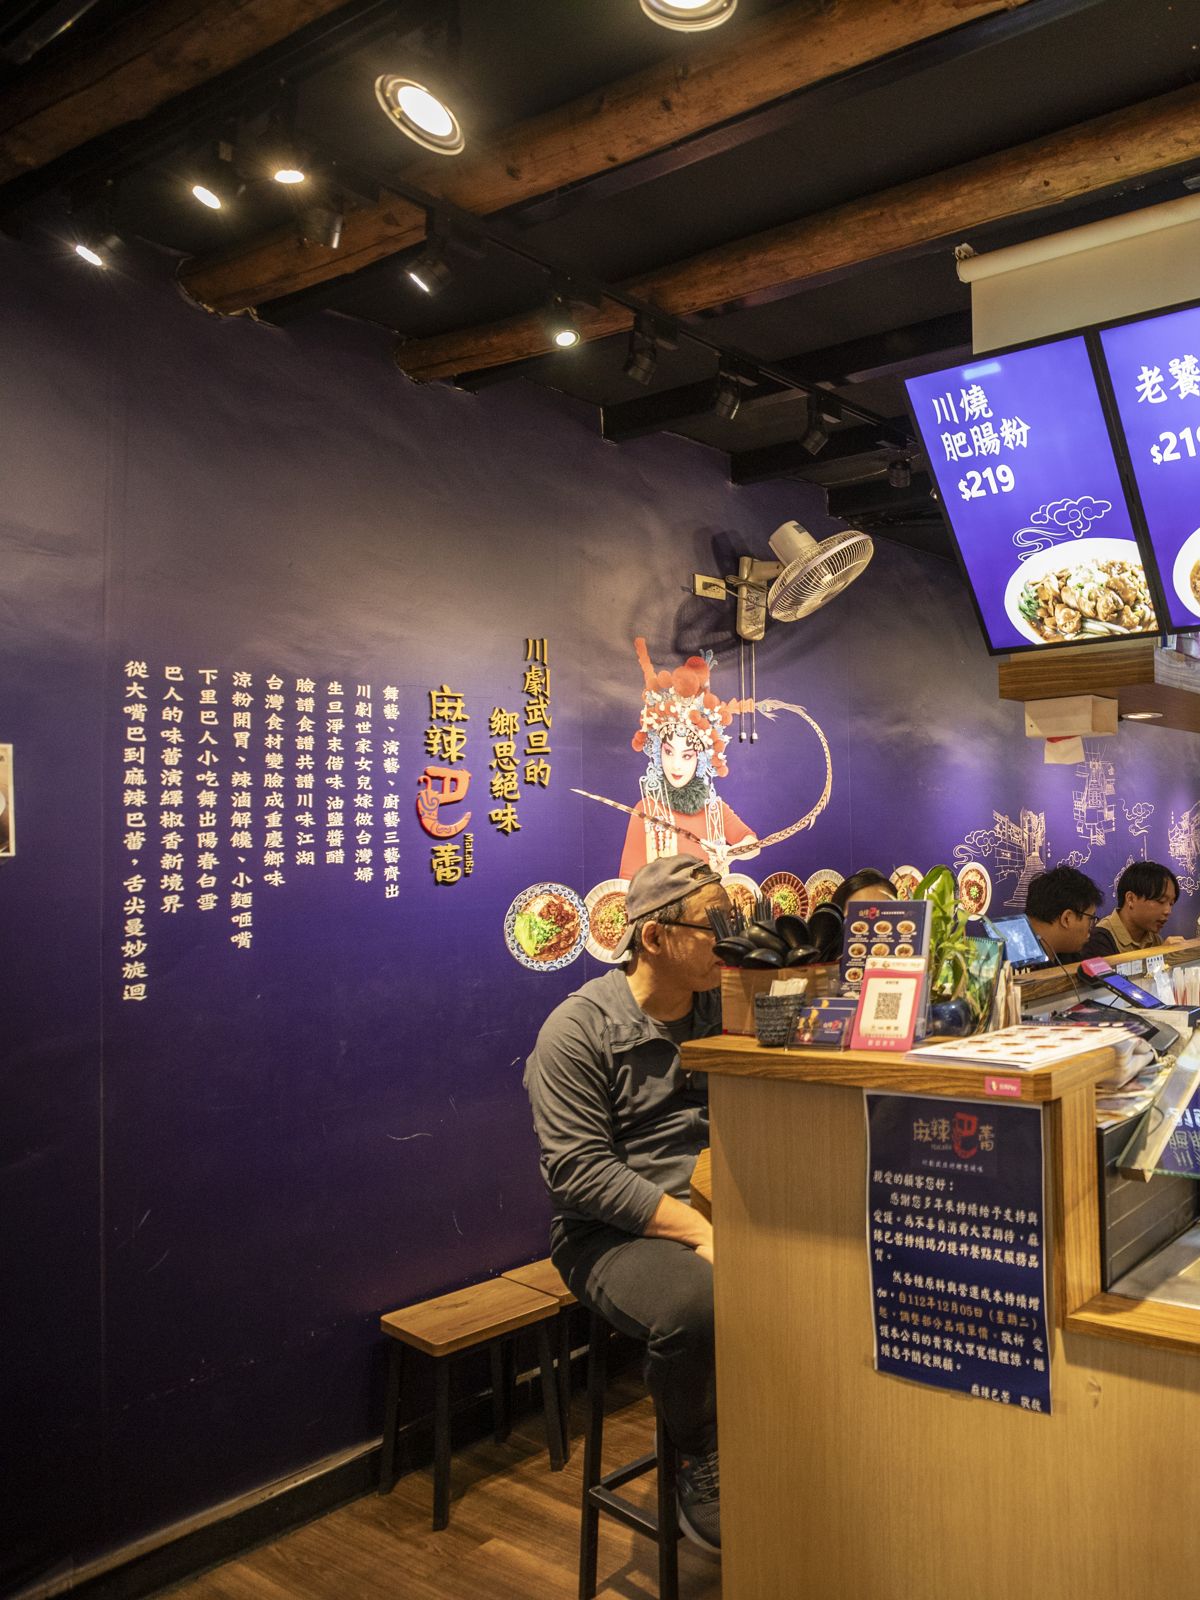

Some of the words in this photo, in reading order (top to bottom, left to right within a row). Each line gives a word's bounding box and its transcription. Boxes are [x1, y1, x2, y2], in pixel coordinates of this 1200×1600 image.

[931, 384, 994, 425] 川燒
[940, 416, 1031, 461] 肥腸粉
[957, 464, 1015, 501] $219
[263, 674, 285, 887] 台灣食材變臉成重慶鄉味
[295, 678, 316, 866] 臉譜食譜共譜川味江湖
[488, 706, 522, 836] 鄉思絕味
[523, 638, 552, 787] 川劇武旦的
[196, 669, 220, 910] 下里巴人小吃舞出陽春白雪
